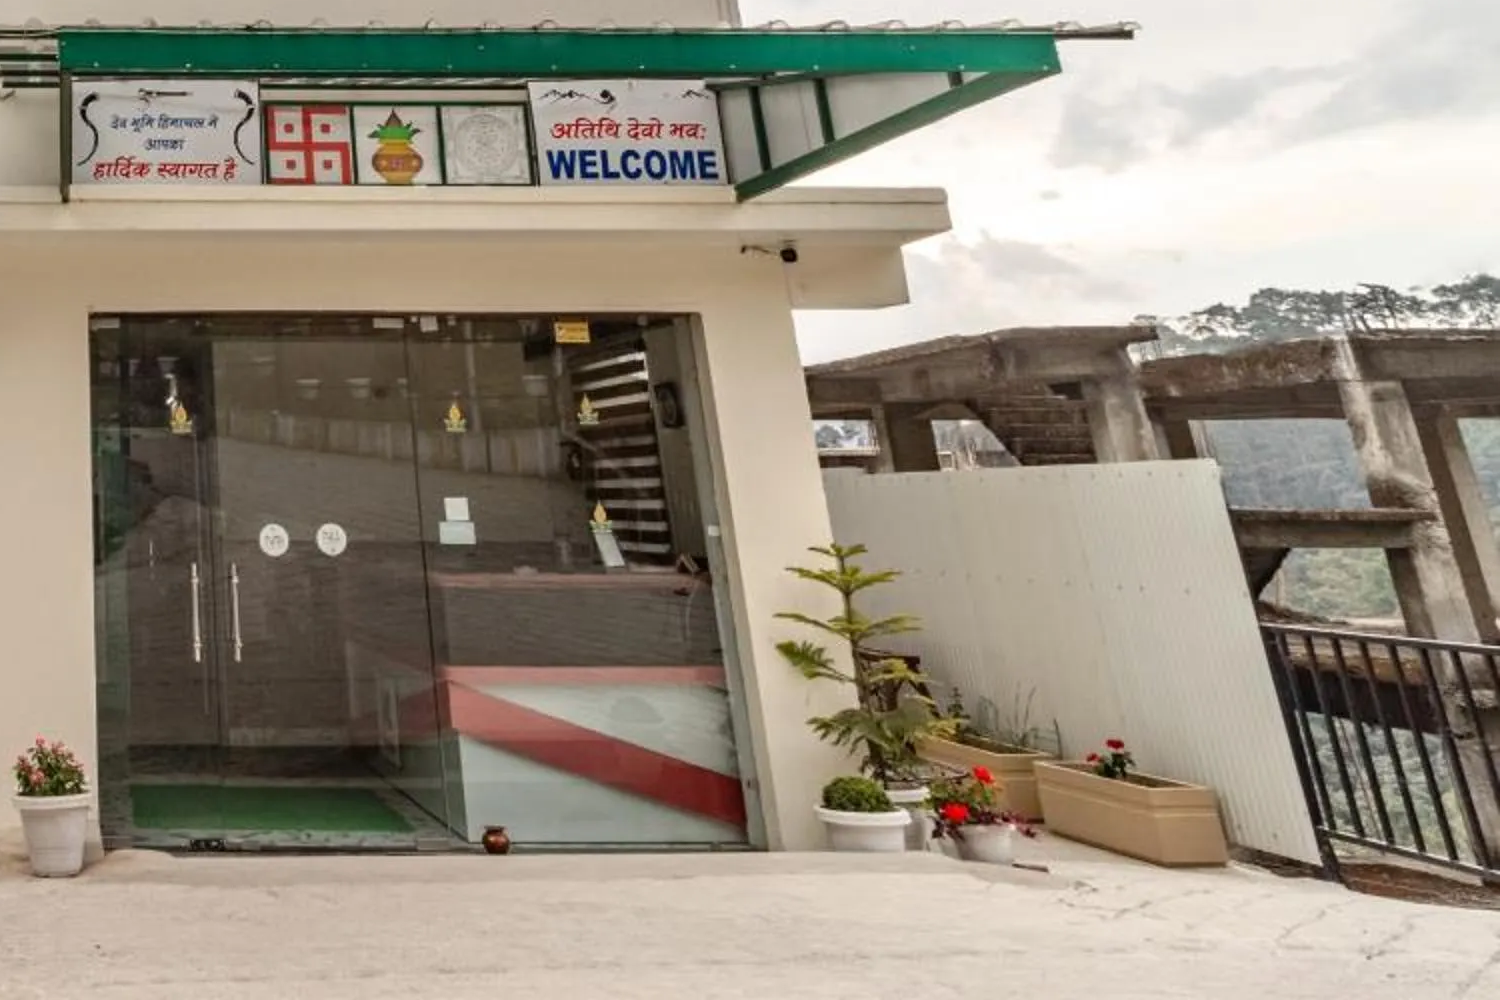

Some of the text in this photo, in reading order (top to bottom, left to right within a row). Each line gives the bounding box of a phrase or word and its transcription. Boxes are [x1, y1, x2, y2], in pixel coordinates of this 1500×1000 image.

[551, 116, 621, 140] अतिथि
[627, 116, 664, 141] देवो
[143, 137, 186, 151] आपका
[92, 155, 238, 181] हार्दिक स्वागत है
[546, 148, 719, 181] WELCOME
